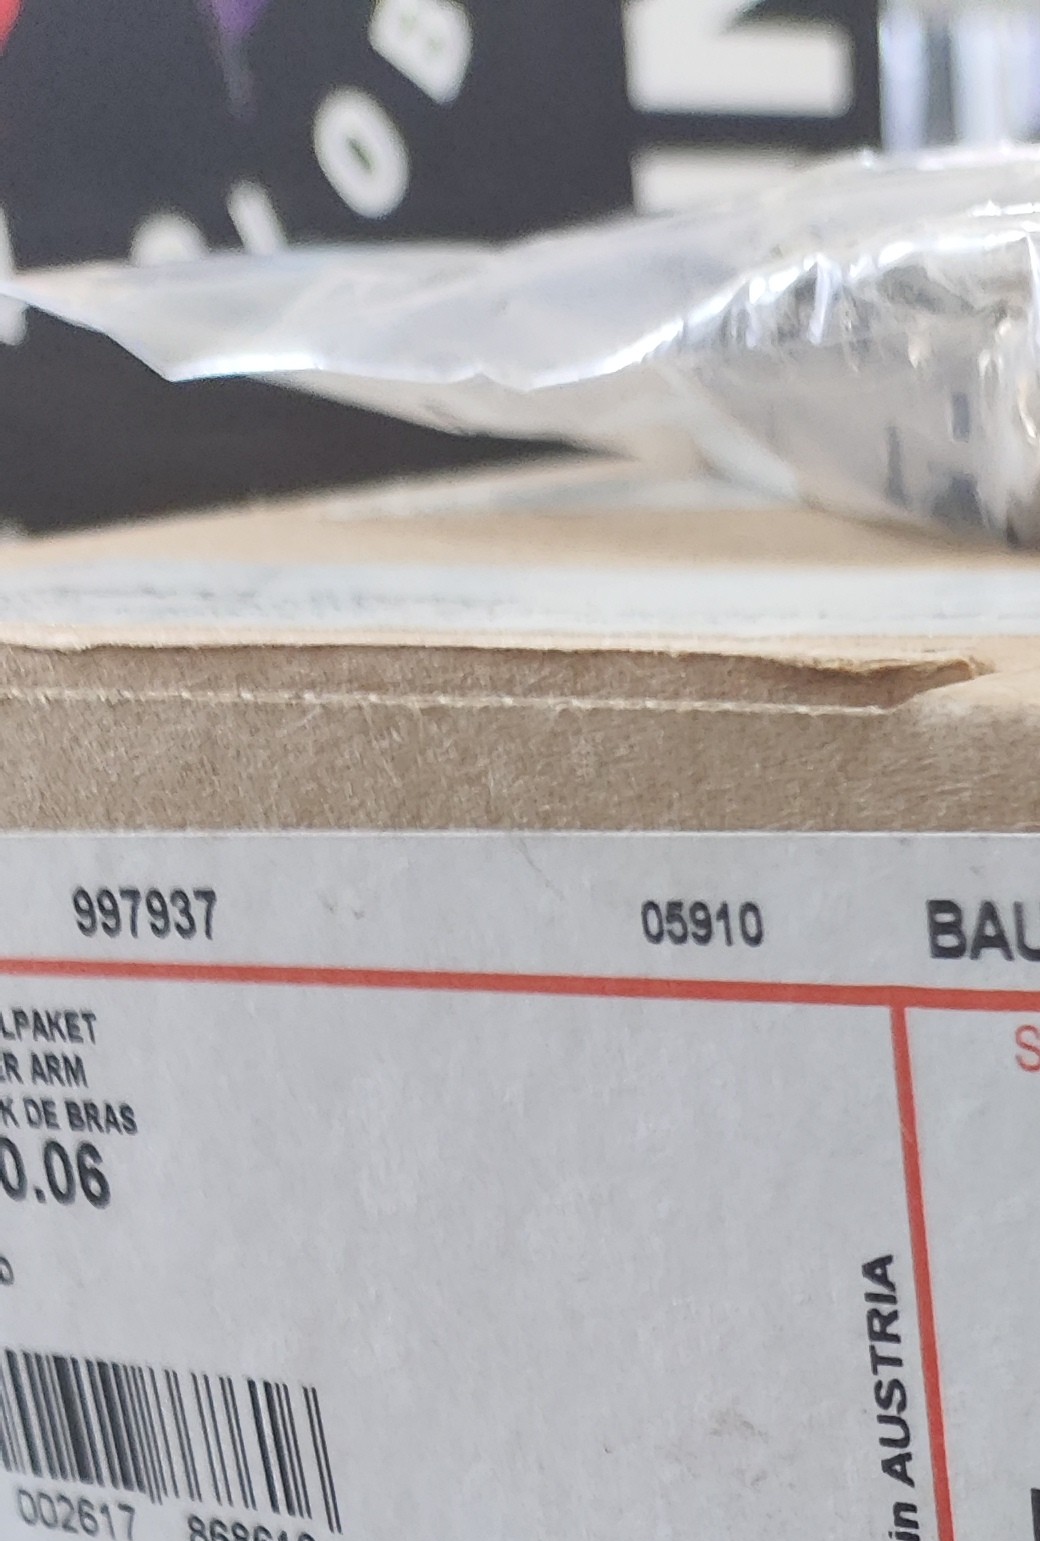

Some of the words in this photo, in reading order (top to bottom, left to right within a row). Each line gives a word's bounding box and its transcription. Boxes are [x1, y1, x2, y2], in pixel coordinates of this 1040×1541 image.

[73, 887, 218, 941] 997937
[641, 898, 765, 950] 05910
[30, 1050, 88, 1088] ARM
[23, 1097, 60, 1131] DE
[64, 1098, 138, 1136] BRAS
[859, 1253, 917, 1487] AUSTRIA
